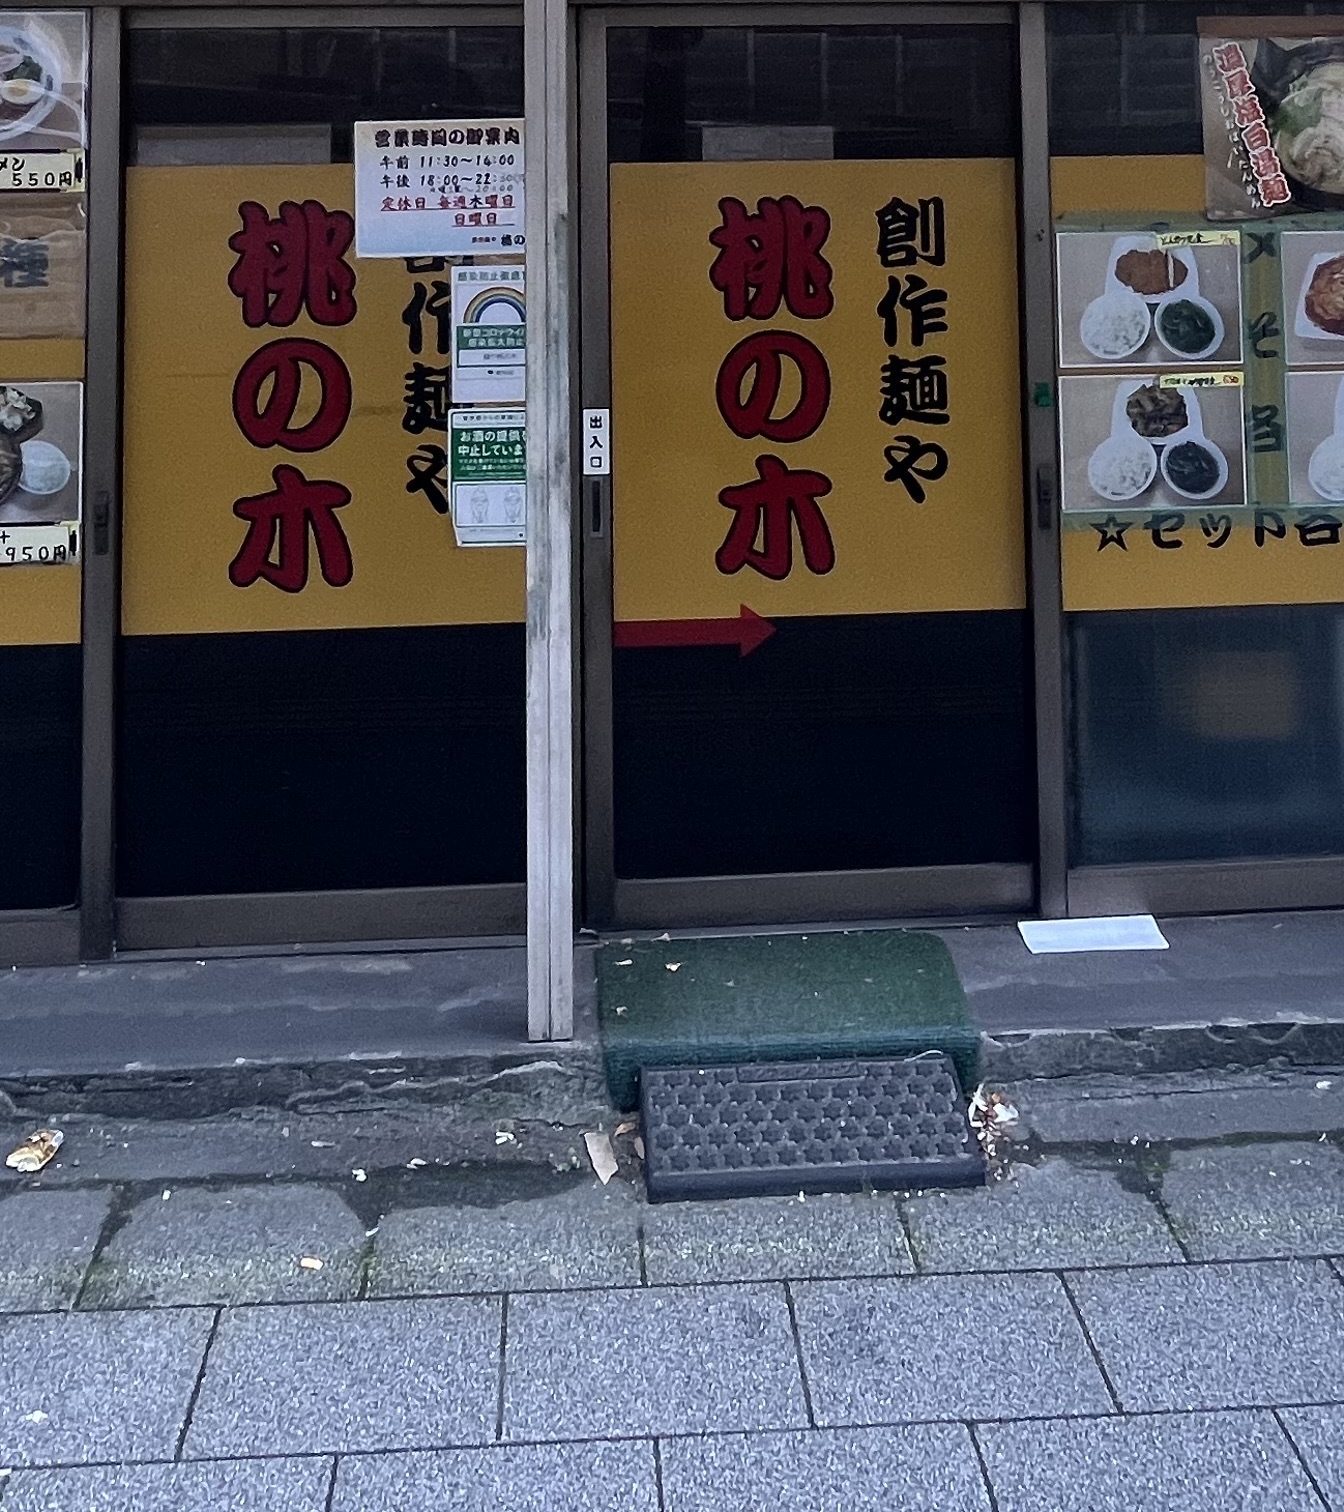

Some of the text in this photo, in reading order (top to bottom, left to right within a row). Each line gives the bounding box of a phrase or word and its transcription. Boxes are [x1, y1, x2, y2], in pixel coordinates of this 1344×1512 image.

[374, 126, 520, 148] 営業時間の御案内
[380, 155, 410, 170] 午前
[12, 172, 72, 186] 550円
[380, 174, 410, 189] 午後
[381, 194, 513, 211] 定休日 毎週木曜日
[454, 212, 497, 226] 日曜日
[875, 196, 951, 504] 創作麺や
[402, 256, 462, 515] 作麺や
[709, 195, 835, 580] 桃の木
[228, 200, 357, 593] 桃の木
[460, 430, 526, 442] お酒の提供
[589, 414, 604, 469] 出入口
[457, 444, 524, 457] 中止していま
